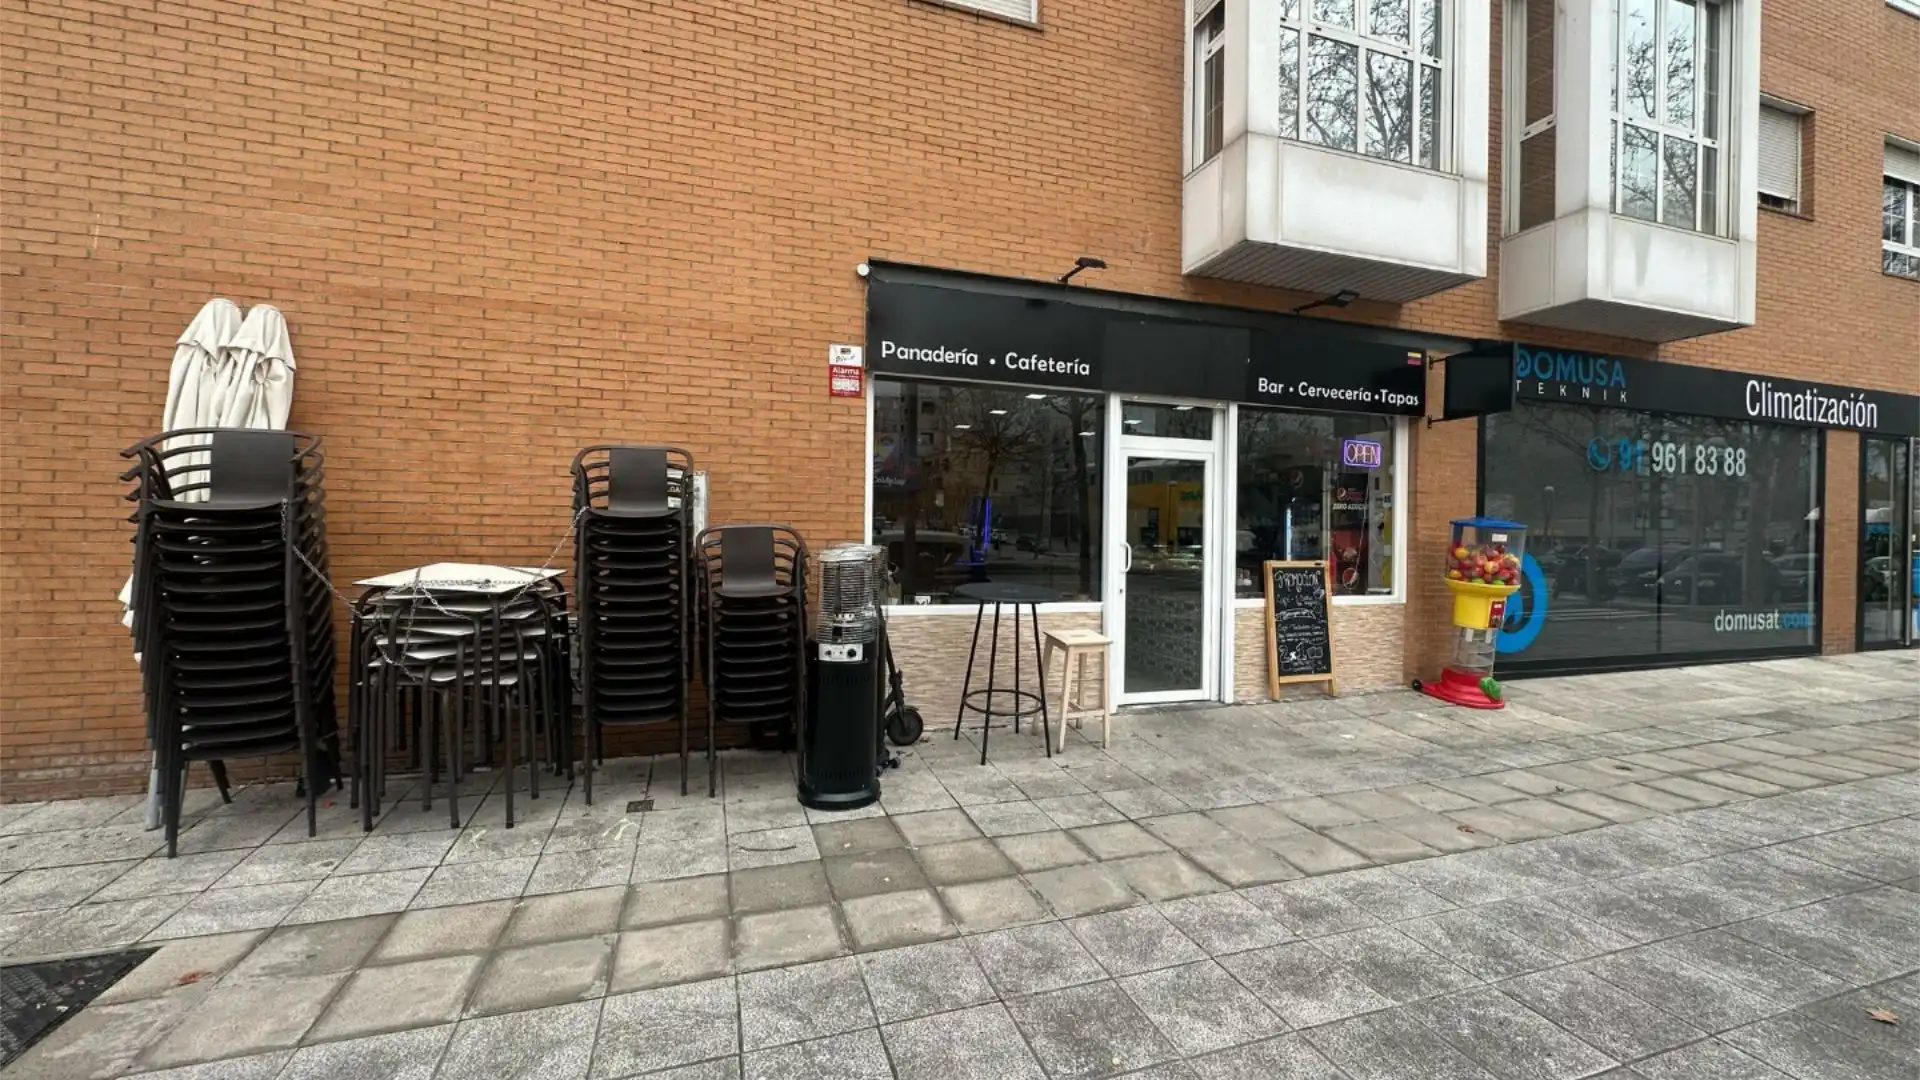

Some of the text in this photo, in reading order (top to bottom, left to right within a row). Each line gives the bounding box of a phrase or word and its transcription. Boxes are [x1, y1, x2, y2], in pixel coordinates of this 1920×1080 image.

[832, 366, 860, 375] Alarma
[881, 340, 1090, 375] Panadería Cafetería
[1515, 348, 1627, 388] DOMUSA
[1258, 377, 1419, 406] Bar Cervecería Tapas
[1515, 380, 1628, 403] TEKNIK
[1745, 379, 1878, 429] Climatización
[1347, 443, 1379, 464] OPEN
[1619, 439, 1746, 476] 91 961 83 88
[1714, 608, 1811, 632] domusat.com
